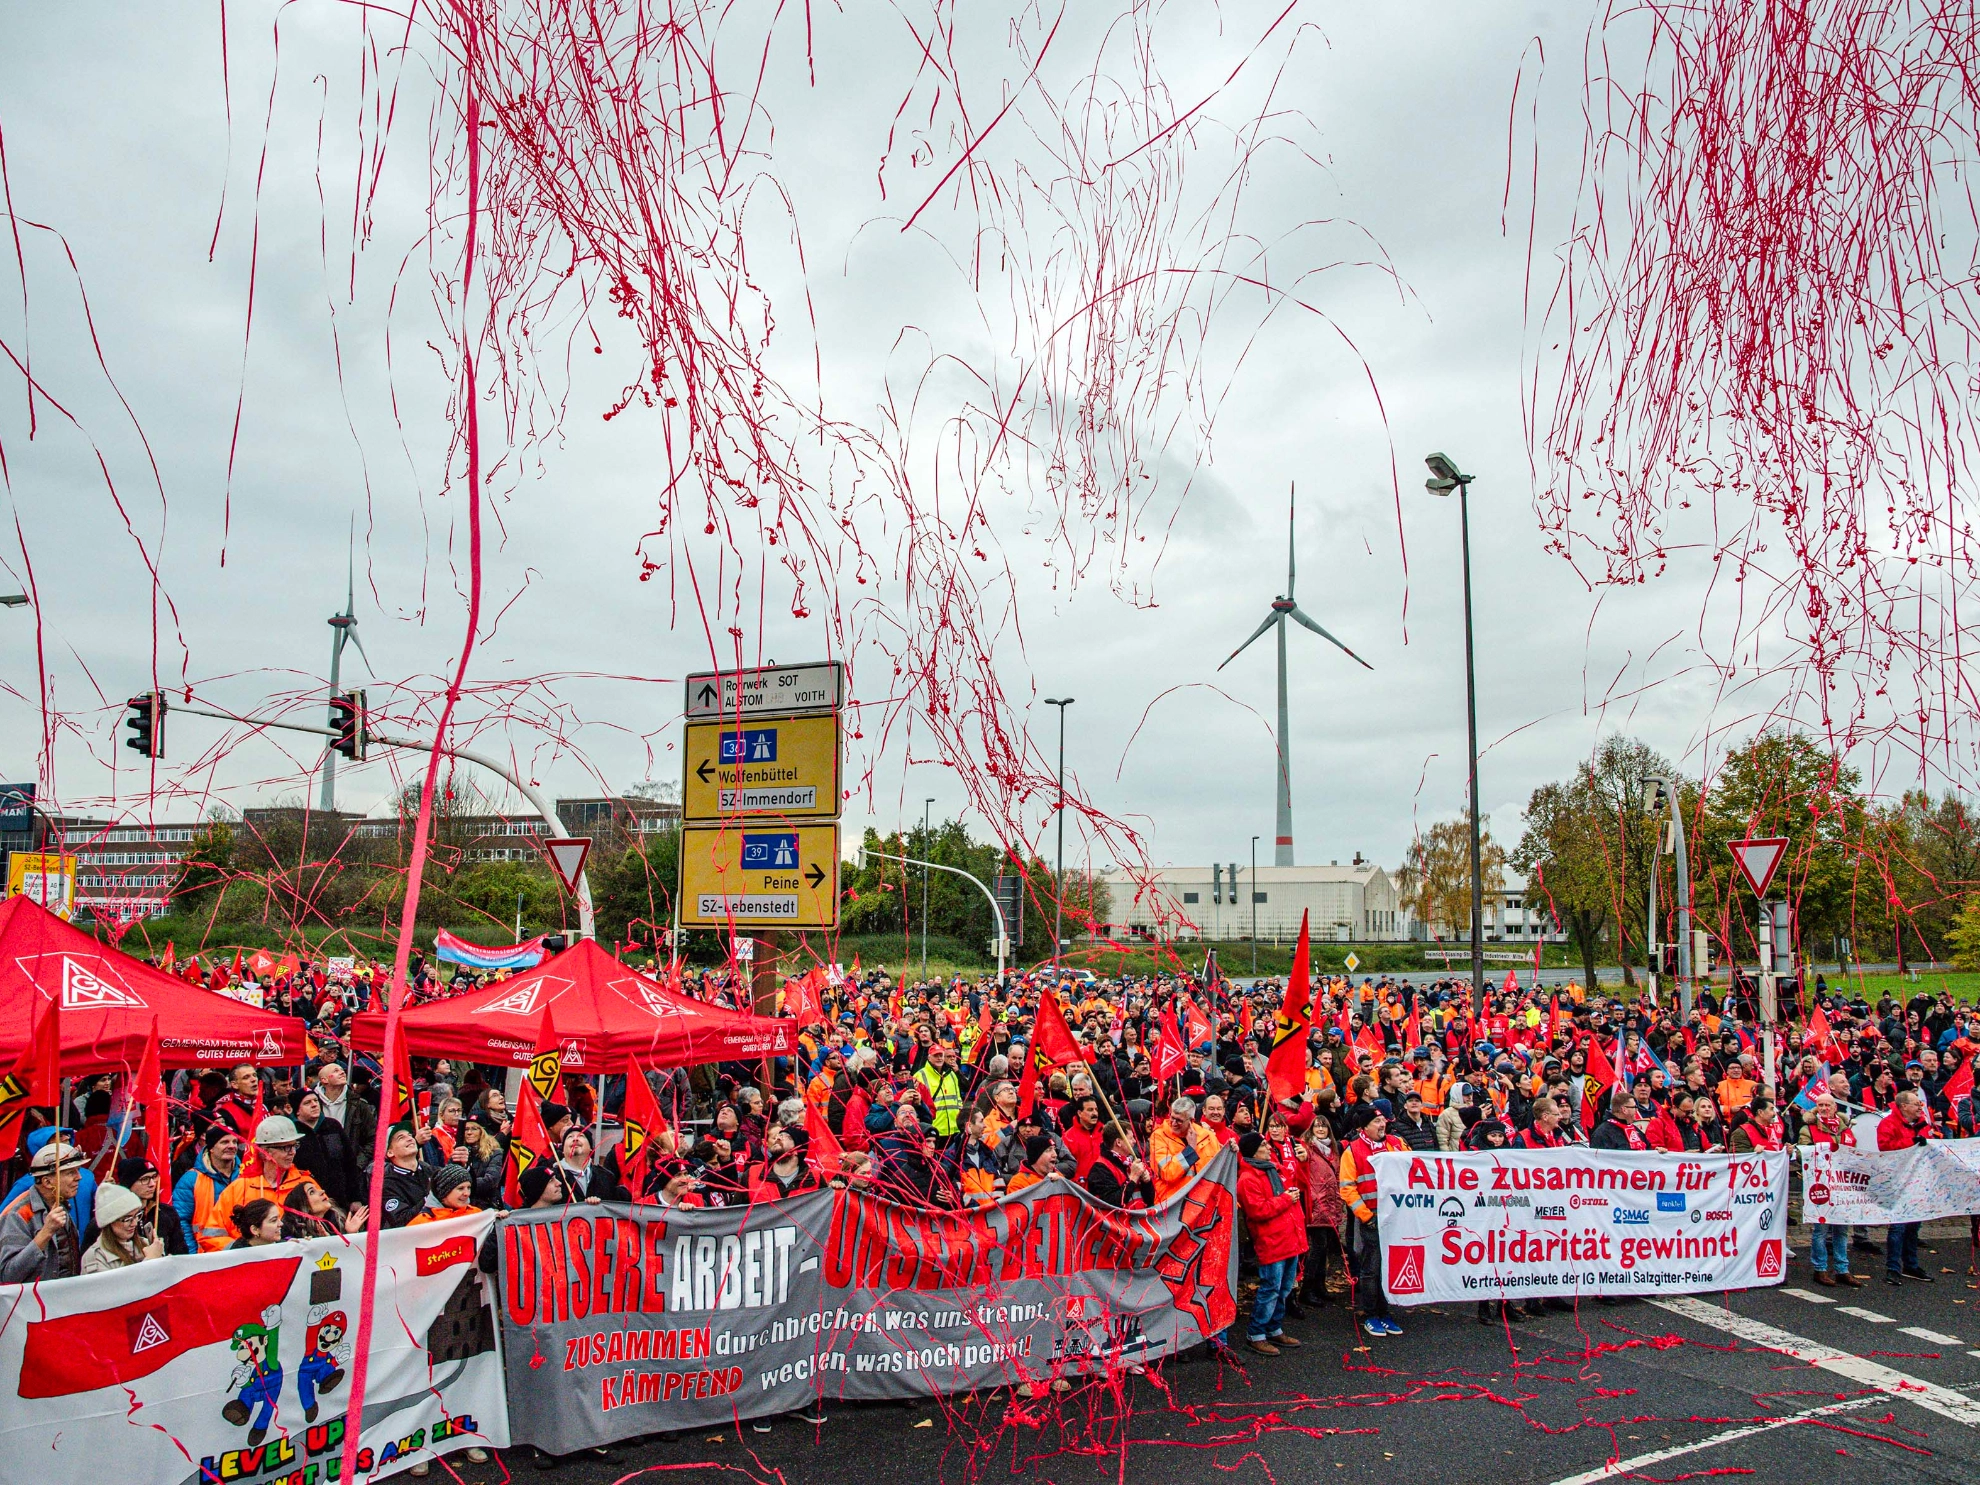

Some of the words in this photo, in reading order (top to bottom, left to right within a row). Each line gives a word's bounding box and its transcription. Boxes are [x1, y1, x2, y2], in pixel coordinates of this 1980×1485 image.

[726, 678, 768, 691] Rohrwerk
[778, 675, 798, 687] SOT
[725, 694, 763, 707] ALSTOM
[795, 690, 825, 702] VOITH
[718, 766, 798, 783] Wolfenbüttel
[721, 790, 813, 807] SZ-Immendorf
[1, 809, 24, 817] MAN
[751, 847, 762, 858] 39
[764, 876, 799, 889] Peine
[702, 899, 795, 914] SZ-Lebenstedt
[161, 1038, 220, 1048] GEMEINSAM
[487, 1038, 530, 1050] GEMEINSAM
[196, 1049, 224, 1059] GUTES
[225, 1049, 252, 1059] LEBEN
[1408, 1157, 1479, 1190] Alle
[1491, 1166, 1666, 1191] zusammen
[1675, 1162, 1717, 1191] für
[1835, 1170, 1871, 1185] MEHR
[1390, 1193, 1435, 1208] VOITH
[1487, 1195, 1531, 1208] MAGNA
[1581, 1198, 1609, 1206] STOLL
[1734, 1191, 1774, 1205] ALSTOM
[1535, 1205, 1565, 1217] MEYER
[1622, 1209, 1650, 1221] SMAG
[1705, 1211, 1733, 1221] BOSCH
[1441, 1228, 1612, 1265] Solidarität
[1620, 1226, 1739, 1269] gewinnt!
[504, 1216, 668, 1326] UNSERE
[670, 1226, 796, 1312] ARBEIT
[825, 1188, 998, 1290] UNSERE
[1462, 1272, 1558, 1289] Vertrauensleute
[1562, 1272, 1579, 1285] der
[1583, 1272, 1595, 1285] IG
[1599, 1271, 1631, 1284] Metall
[1633, 1271, 1713, 1287] Salzgitter-Peine
[564, 1326, 711, 1372] ZUSAMMEN
[715, 1306, 882, 1355] durchbrechen,
[884, 1310, 929, 1331] was
[934, 1307, 973, 1329] uns
[977, 1301, 1050, 1324] trennt,
[601, 1366, 744, 1412] KÄMPFEND
[856, 1352, 902, 1373] was
[906, 1343, 961, 1371] noch
[963, 1334, 1033, 1369] pennt!
[379, 1428, 427, 1464] ANS
[432, 1415, 478, 1445] ZIEL
[200, 1435, 296, 1483] LEVEL
